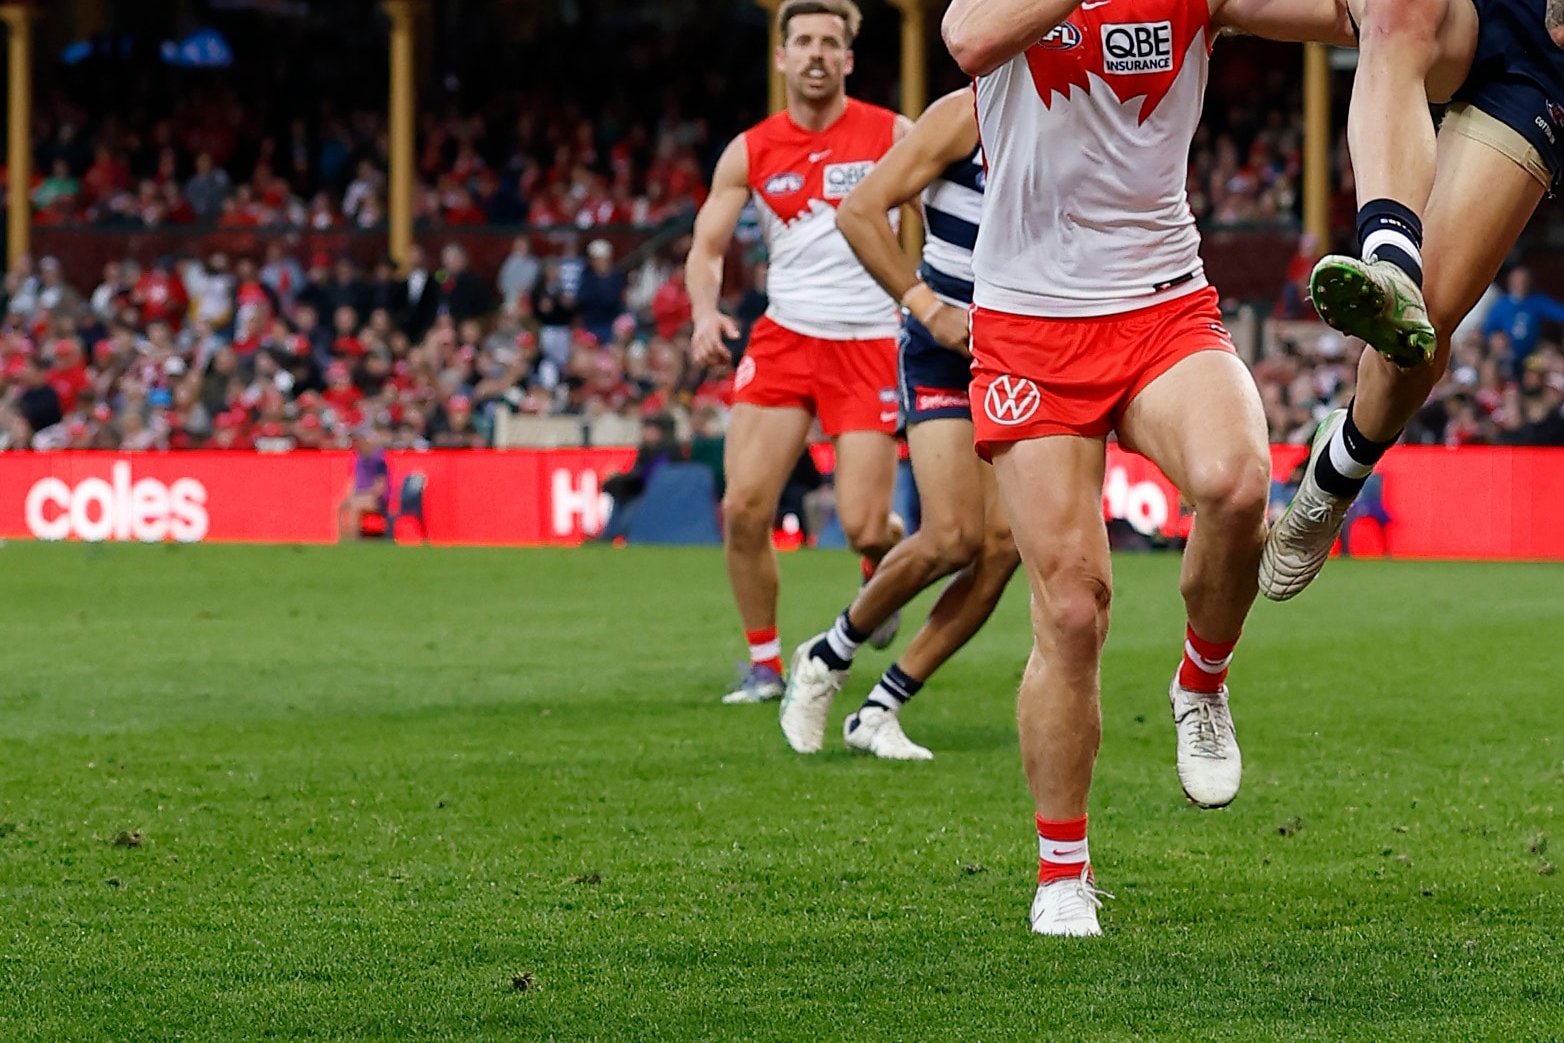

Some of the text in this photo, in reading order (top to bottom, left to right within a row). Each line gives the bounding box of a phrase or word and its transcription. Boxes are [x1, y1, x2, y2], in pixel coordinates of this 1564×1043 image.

[1042, 26, 1076, 45] FL
[1105, 26, 1170, 58] QBE
[1106, 57, 1171, 72] INSURANCE
[26, 462, 209, 542] coles
